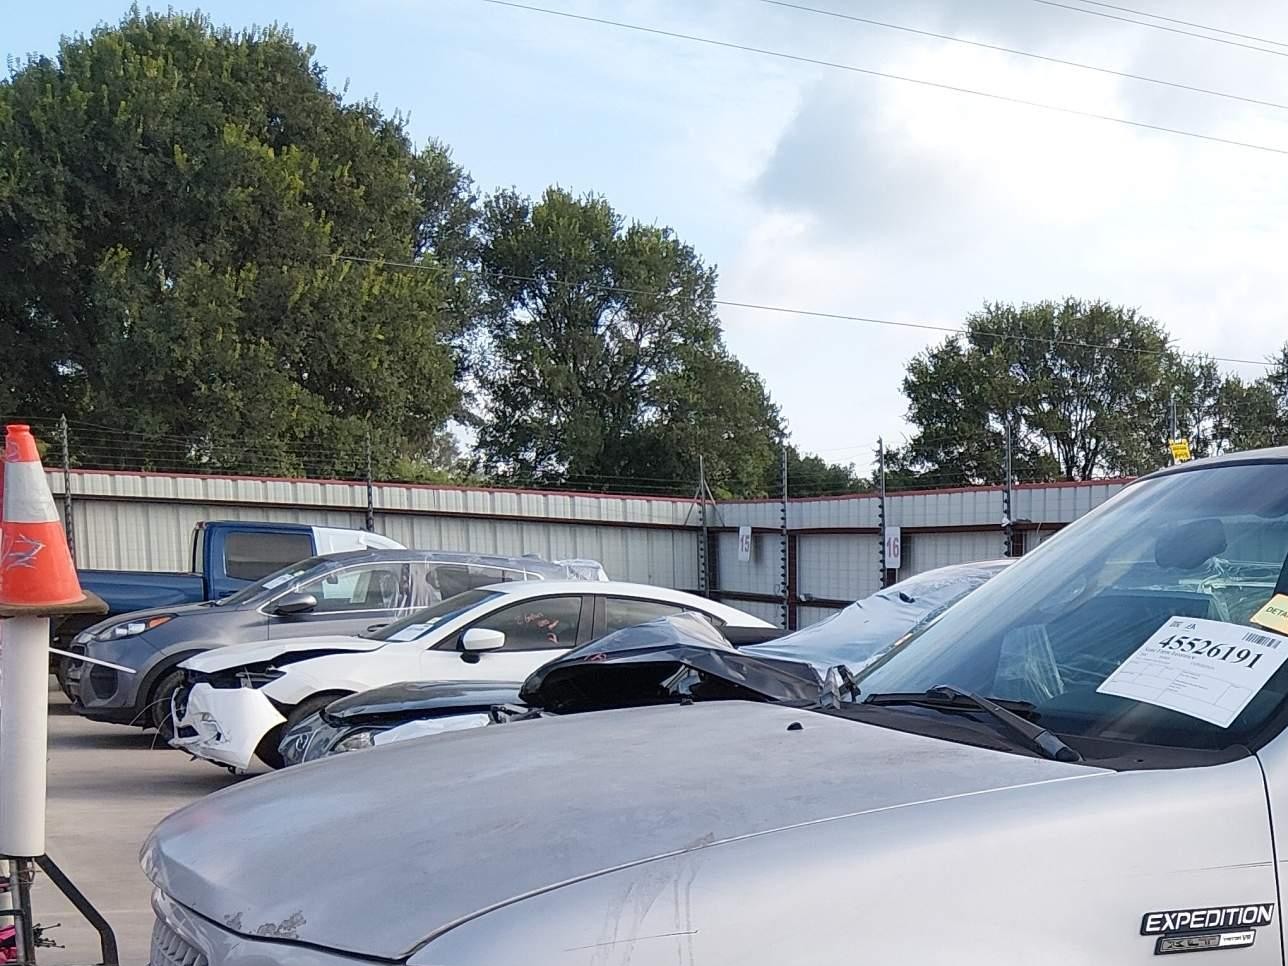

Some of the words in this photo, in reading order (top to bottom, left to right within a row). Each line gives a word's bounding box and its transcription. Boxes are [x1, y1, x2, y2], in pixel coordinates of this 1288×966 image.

[740, 535, 750, 552] 15
[886, 537, 899, 557] 16
[1159, 635, 1264, 669] 45526191
[1145, 905, 1274, 932] EXPEDITION
